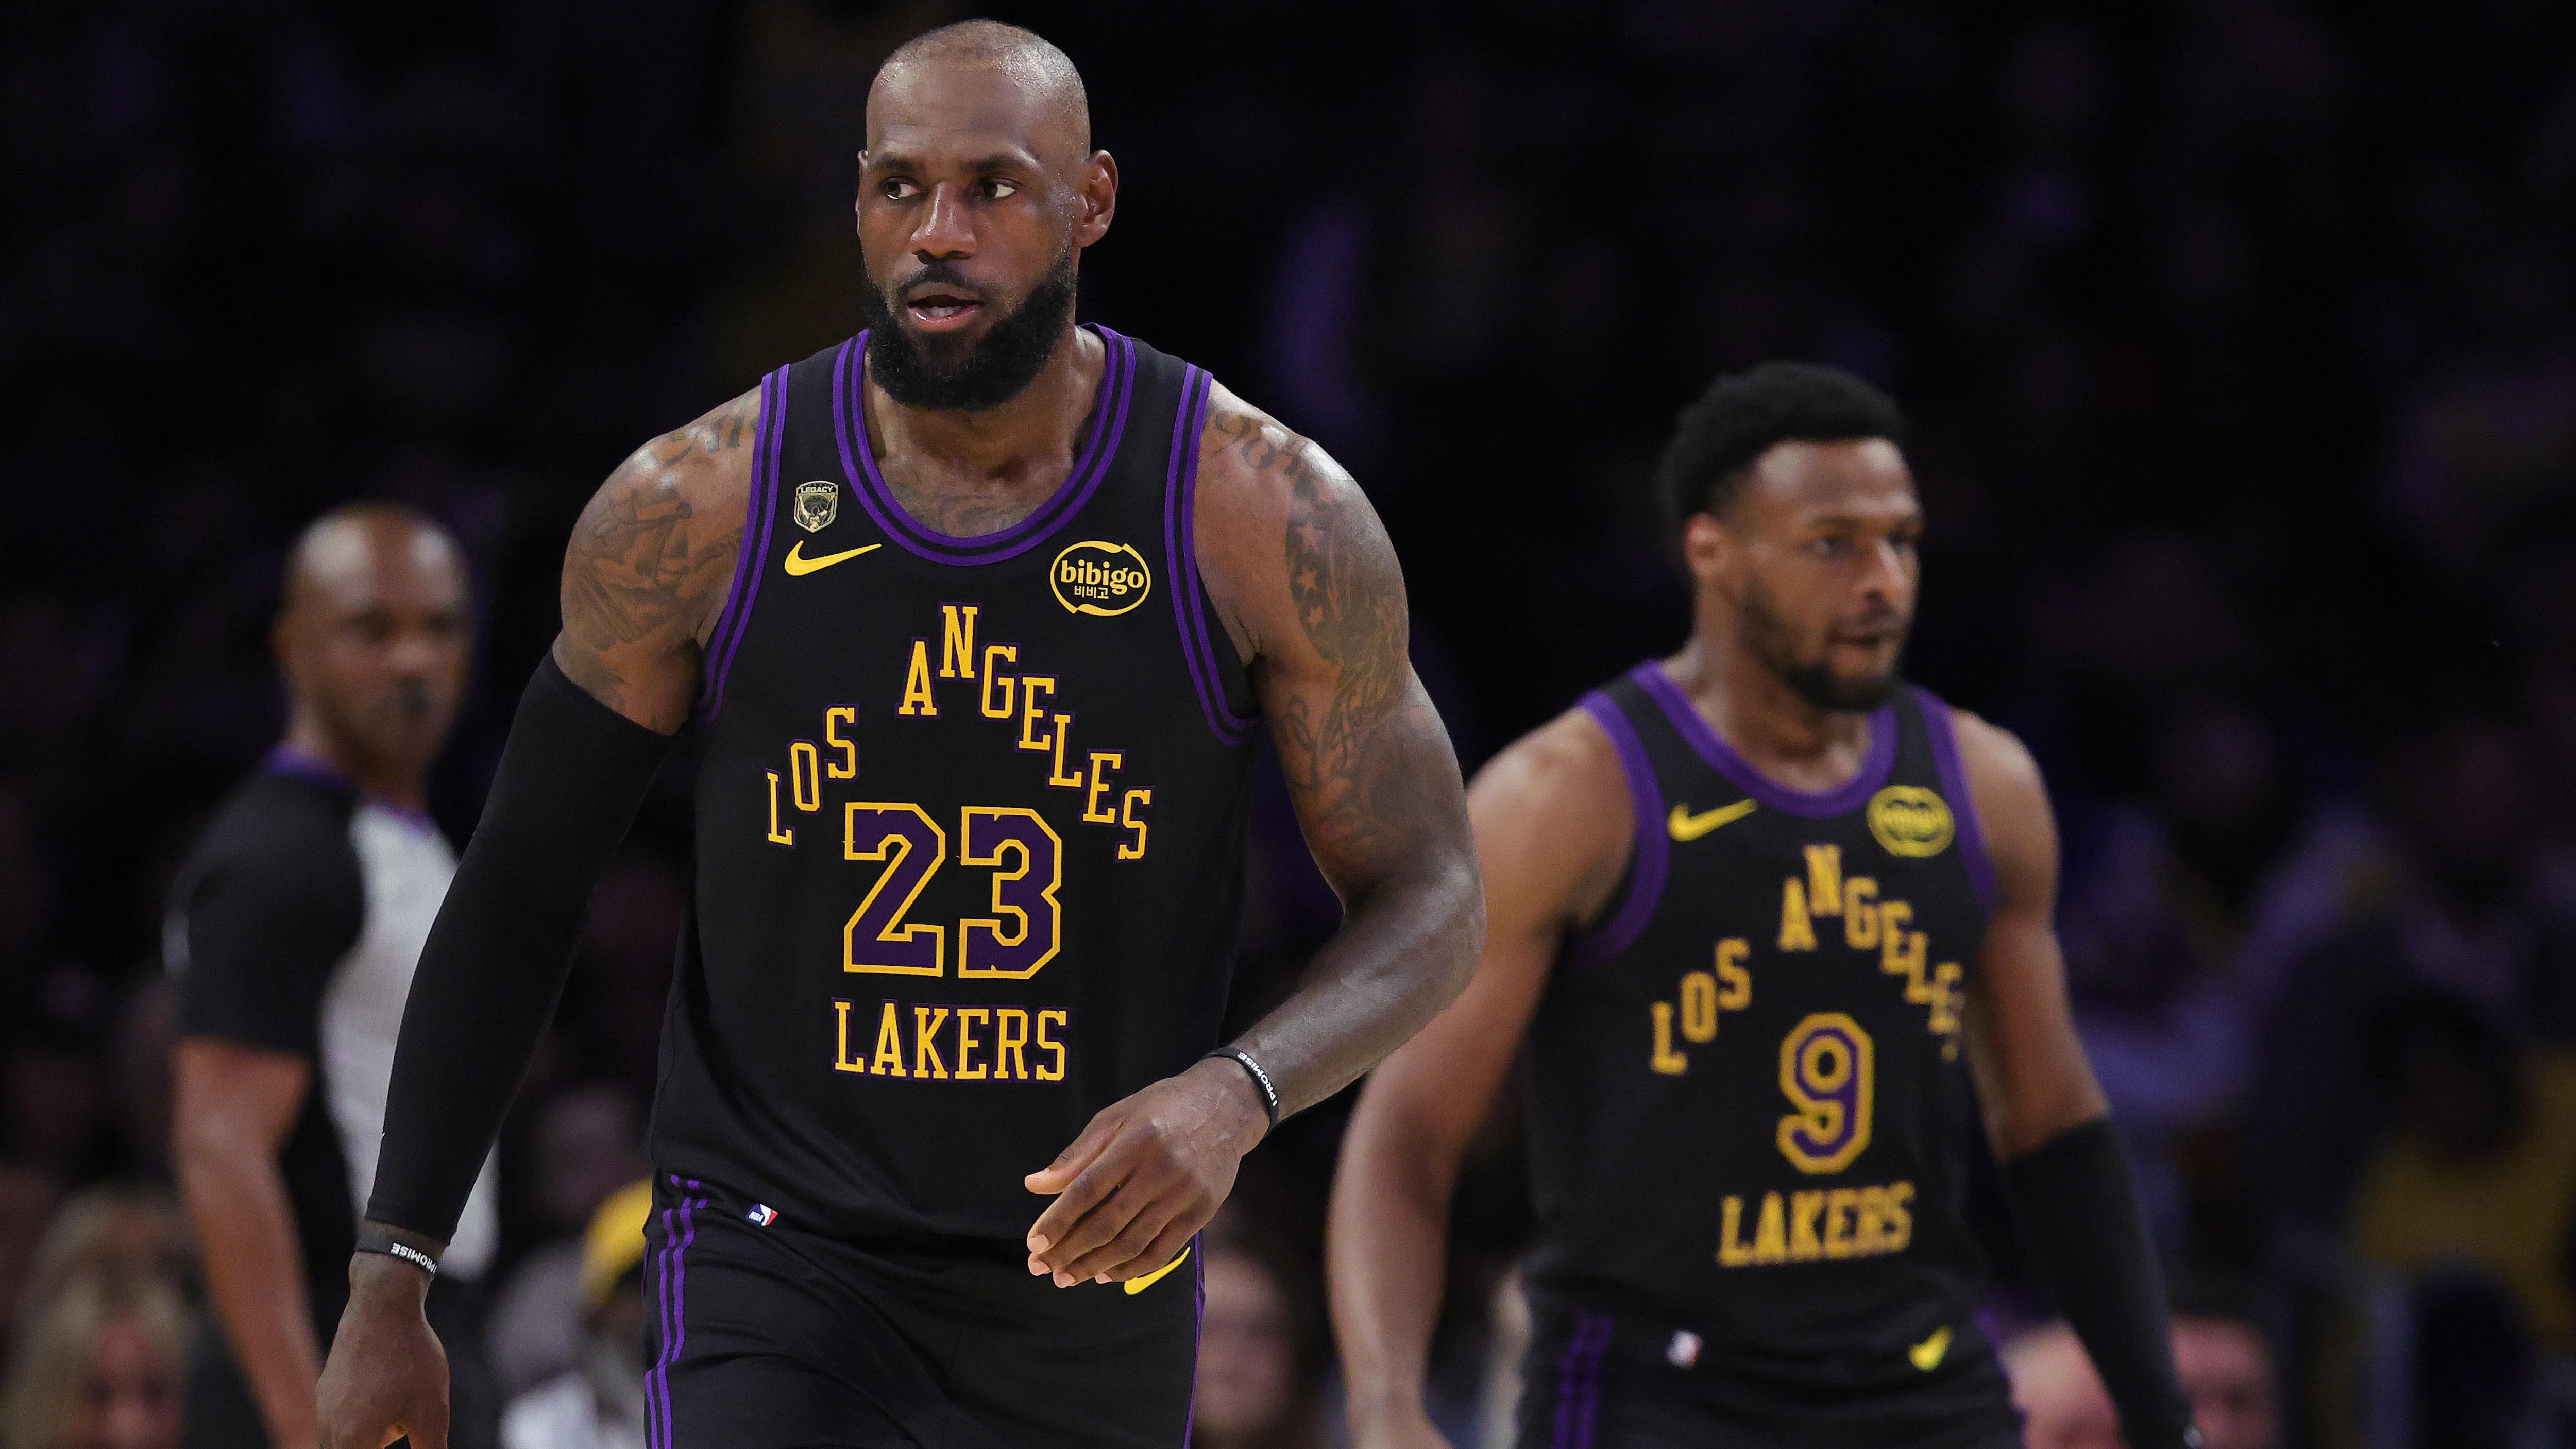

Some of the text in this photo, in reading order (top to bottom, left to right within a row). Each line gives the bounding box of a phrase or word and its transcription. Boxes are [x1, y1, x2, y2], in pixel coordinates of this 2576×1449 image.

[1060, 559, 1144, 595] bibigo
[1074, 585, 1109, 599] 비비고
[766, 604, 1152, 861] LOS ANGELES
[843, 802, 1062, 980] 23
[833, 999, 1069, 1082] LAKERS
[1651, 937, 1751, 1076] LOS
[1237, 1052, 1276, 1101] PROMISE
[1776, 1011, 1875, 1174] 9
[391, 1242, 436, 1272] PROMISE
[748, 1211, 764, 1222] NBA
[1716, 1179, 1917, 1267] LAKERS
